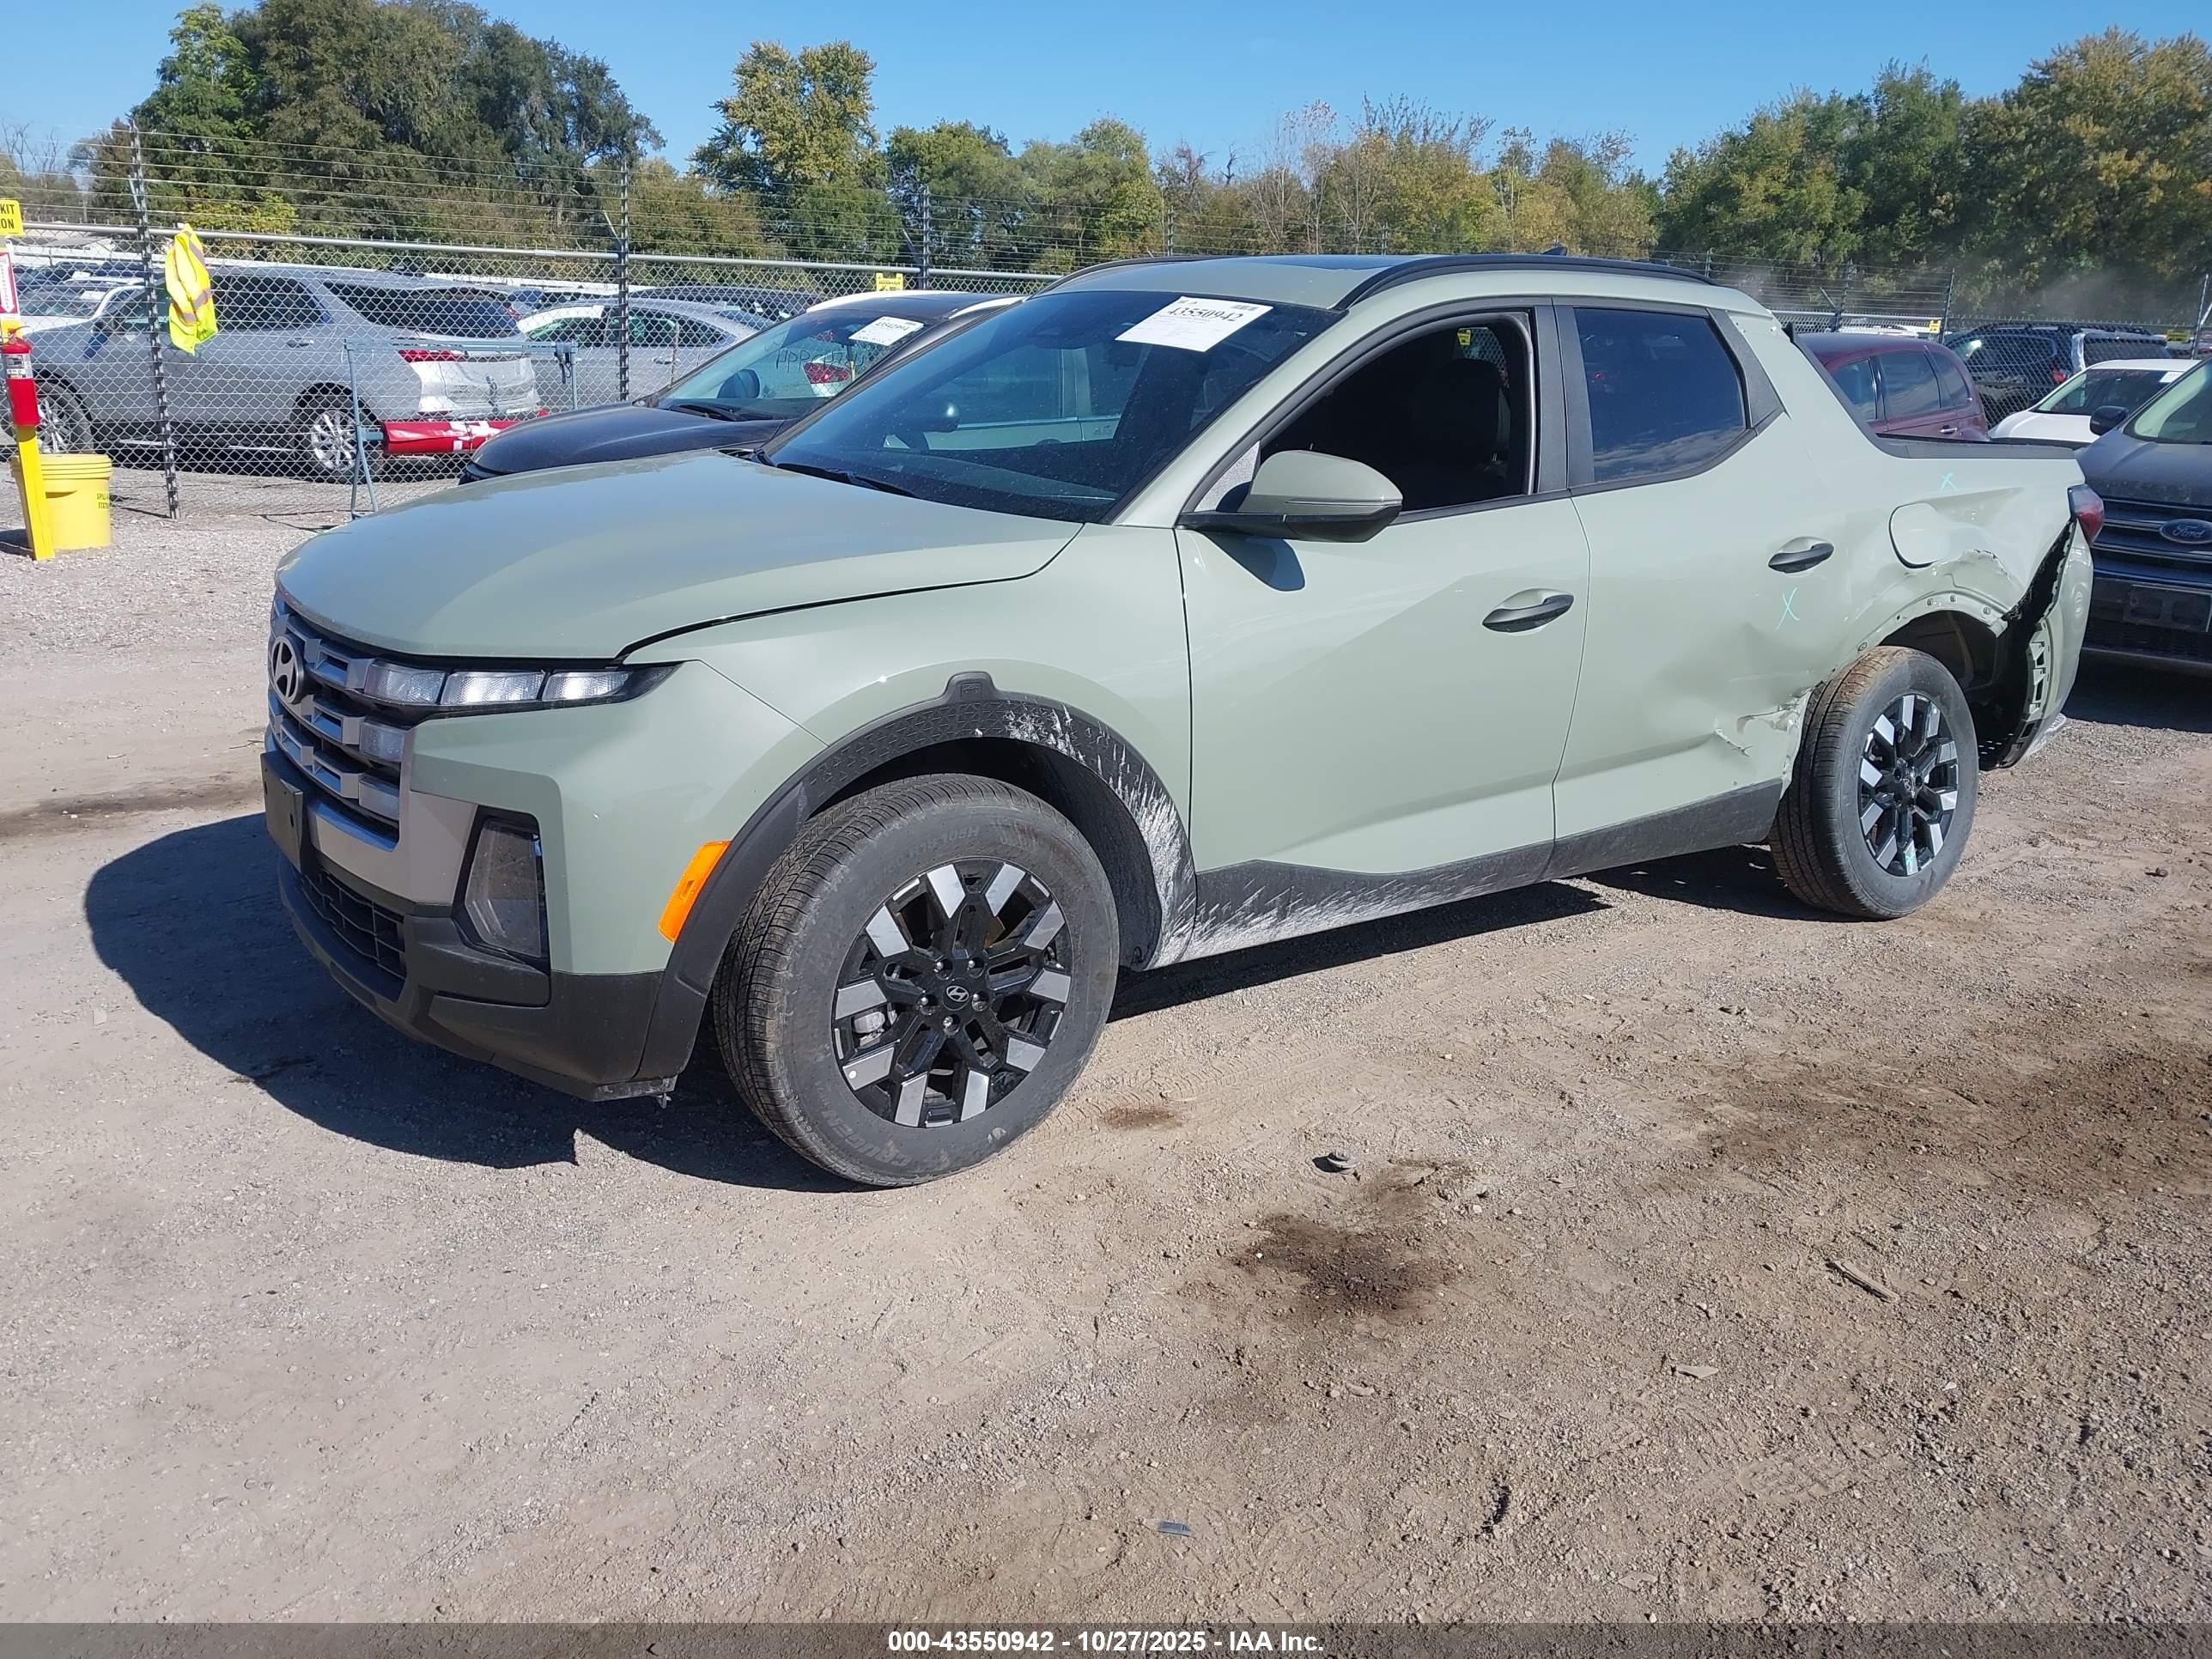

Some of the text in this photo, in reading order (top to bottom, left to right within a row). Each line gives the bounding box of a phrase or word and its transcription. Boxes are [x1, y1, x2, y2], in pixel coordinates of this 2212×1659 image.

[0, 204, 15, 215] KIT
[1167, 307, 1244, 322] 43550942
[2172, 524, 2206, 538] Ford
